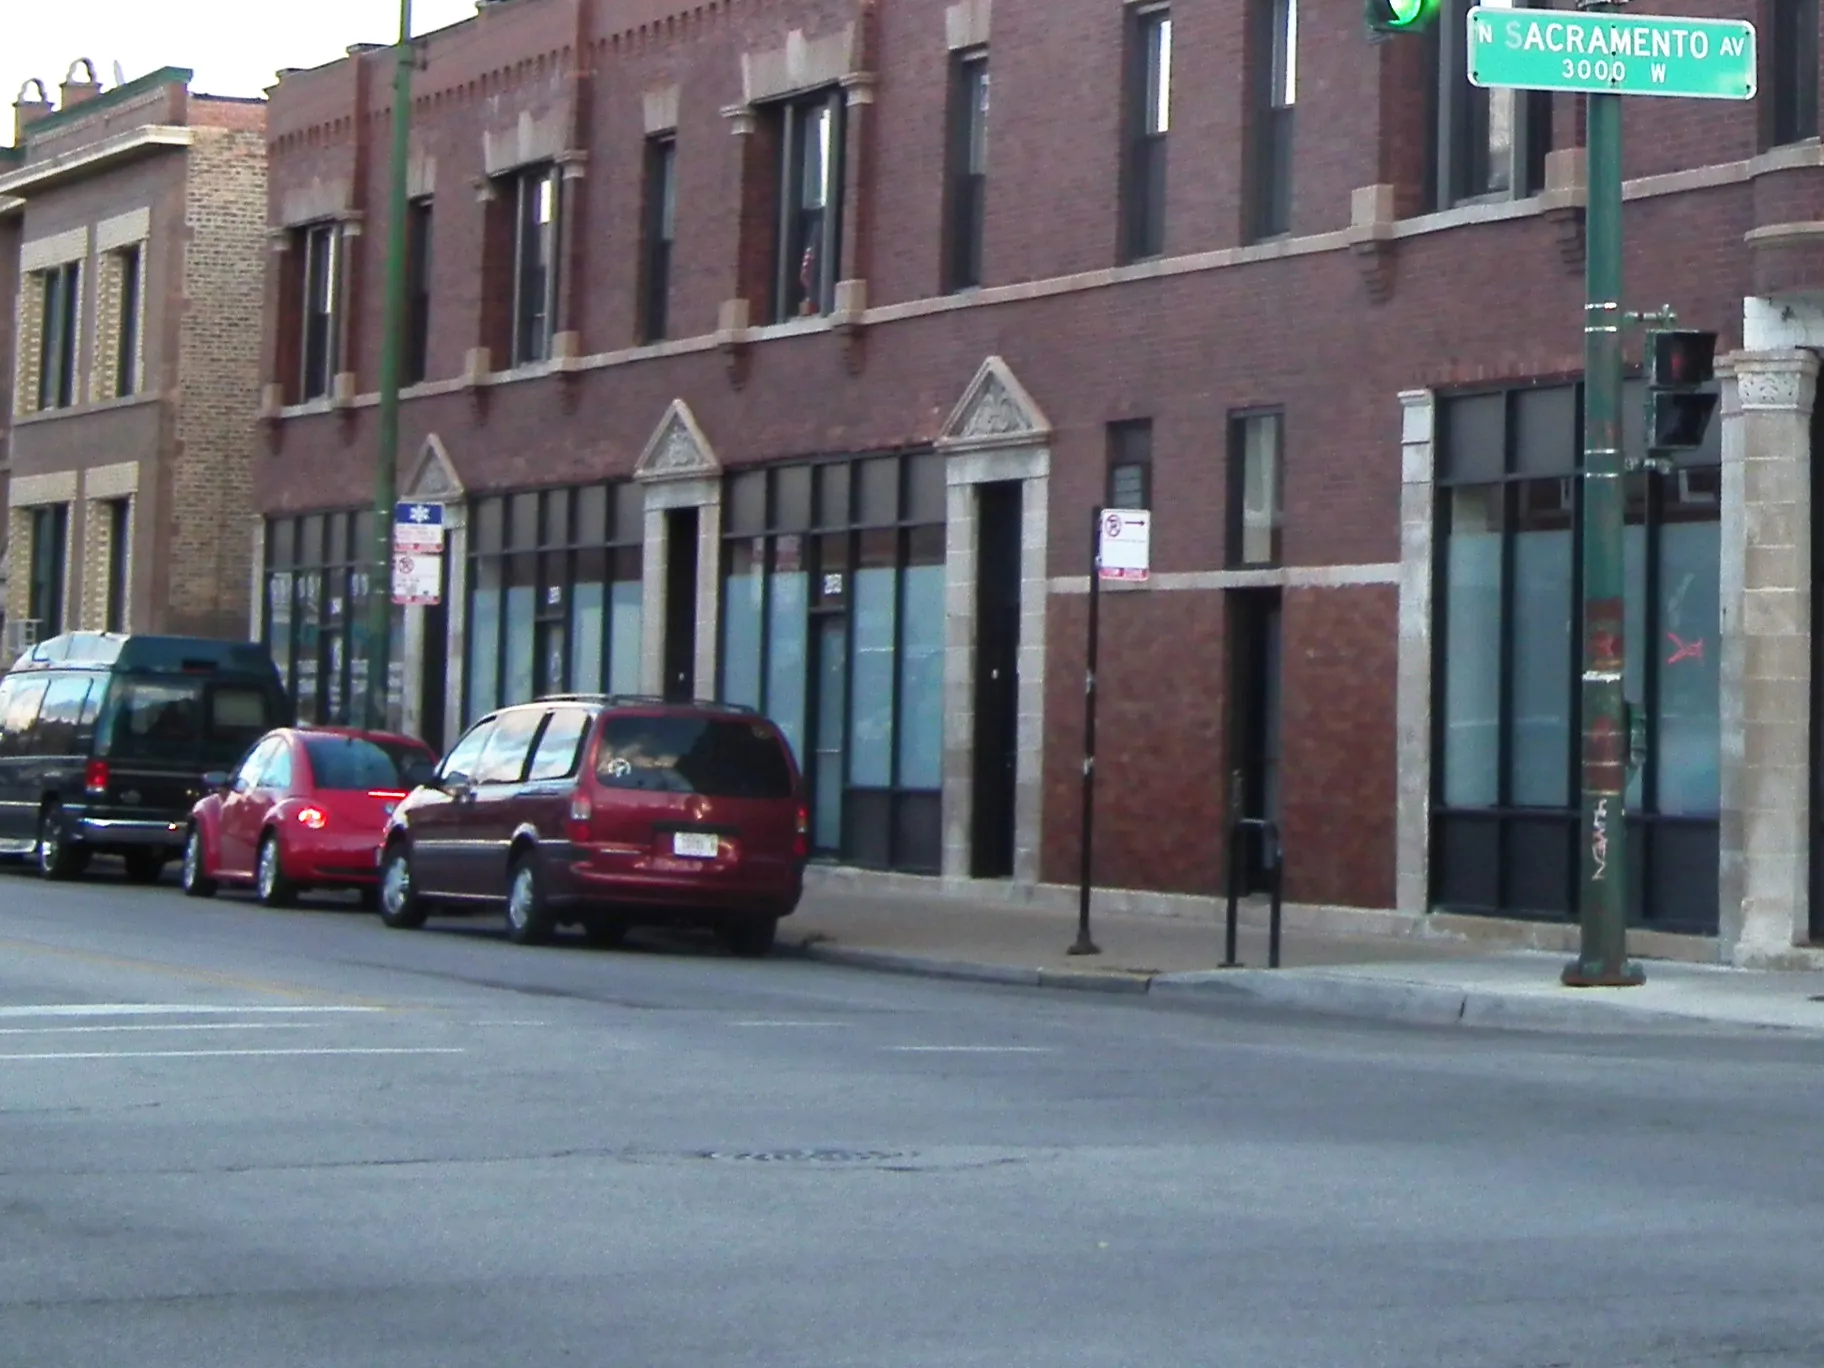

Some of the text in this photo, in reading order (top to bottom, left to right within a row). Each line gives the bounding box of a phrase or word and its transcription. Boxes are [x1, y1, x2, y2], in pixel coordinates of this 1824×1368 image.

[1478, 20, 1745, 60] N SACRAMENTO AV
[1561, 59, 1667, 84] 3000 W
